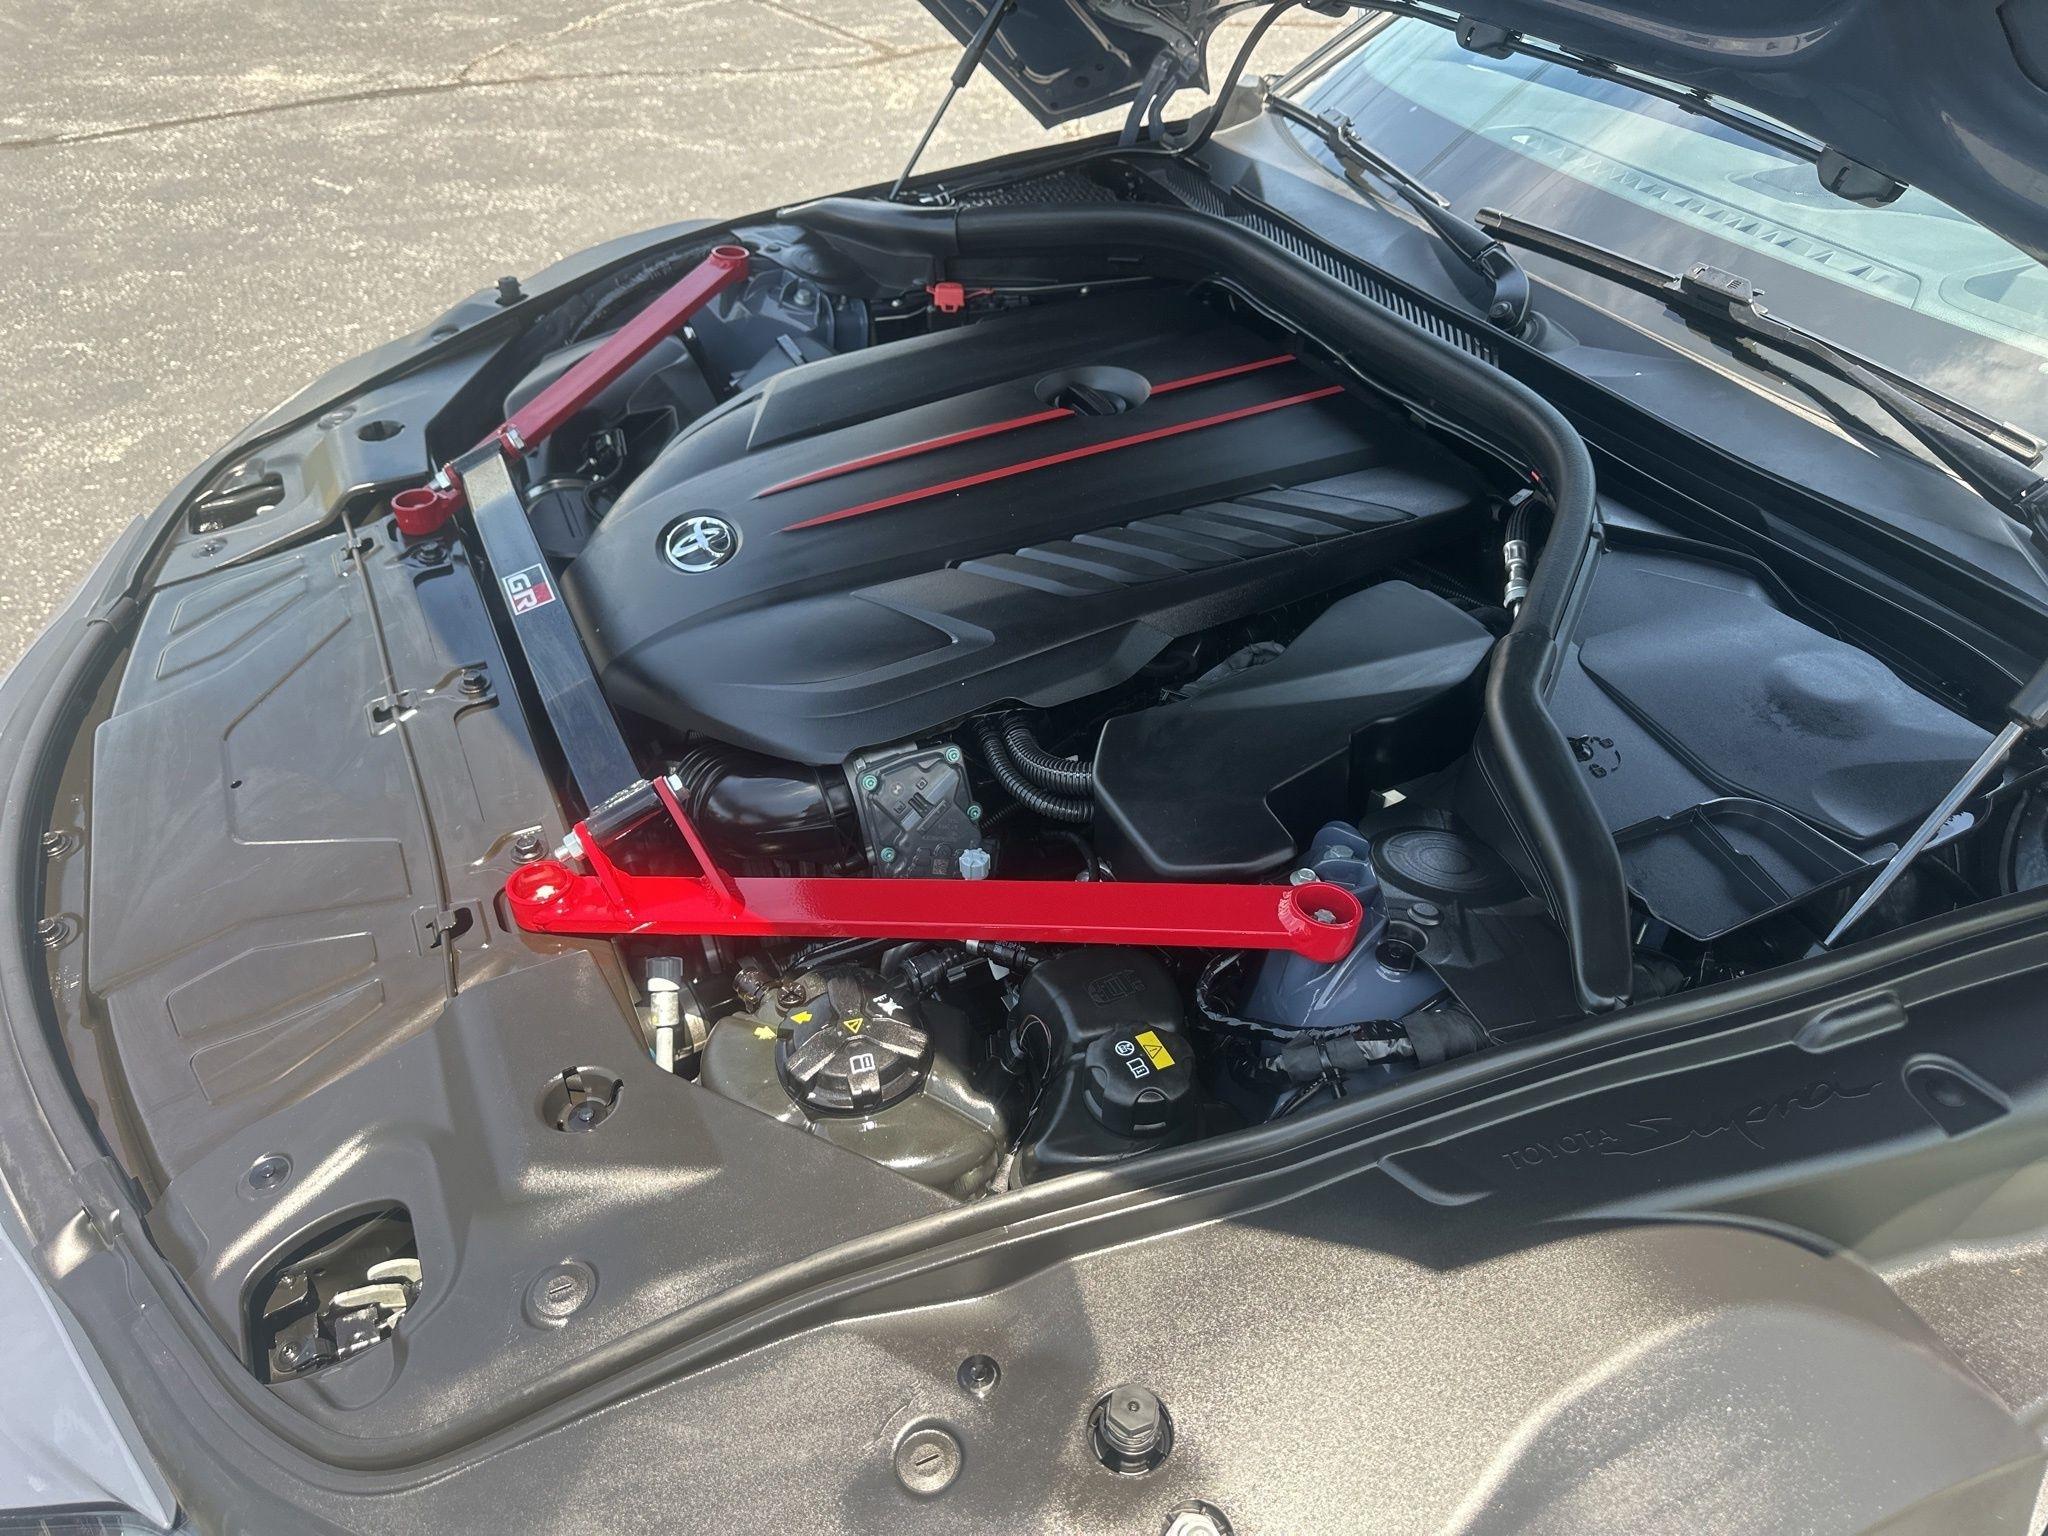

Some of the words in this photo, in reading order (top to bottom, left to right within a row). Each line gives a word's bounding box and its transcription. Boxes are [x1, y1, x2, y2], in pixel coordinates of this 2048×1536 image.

[507, 573, 538, 612] GR
[1501, 1128, 1620, 1170] TOYOTA
[1601, 1082, 1884, 1156] Supra
